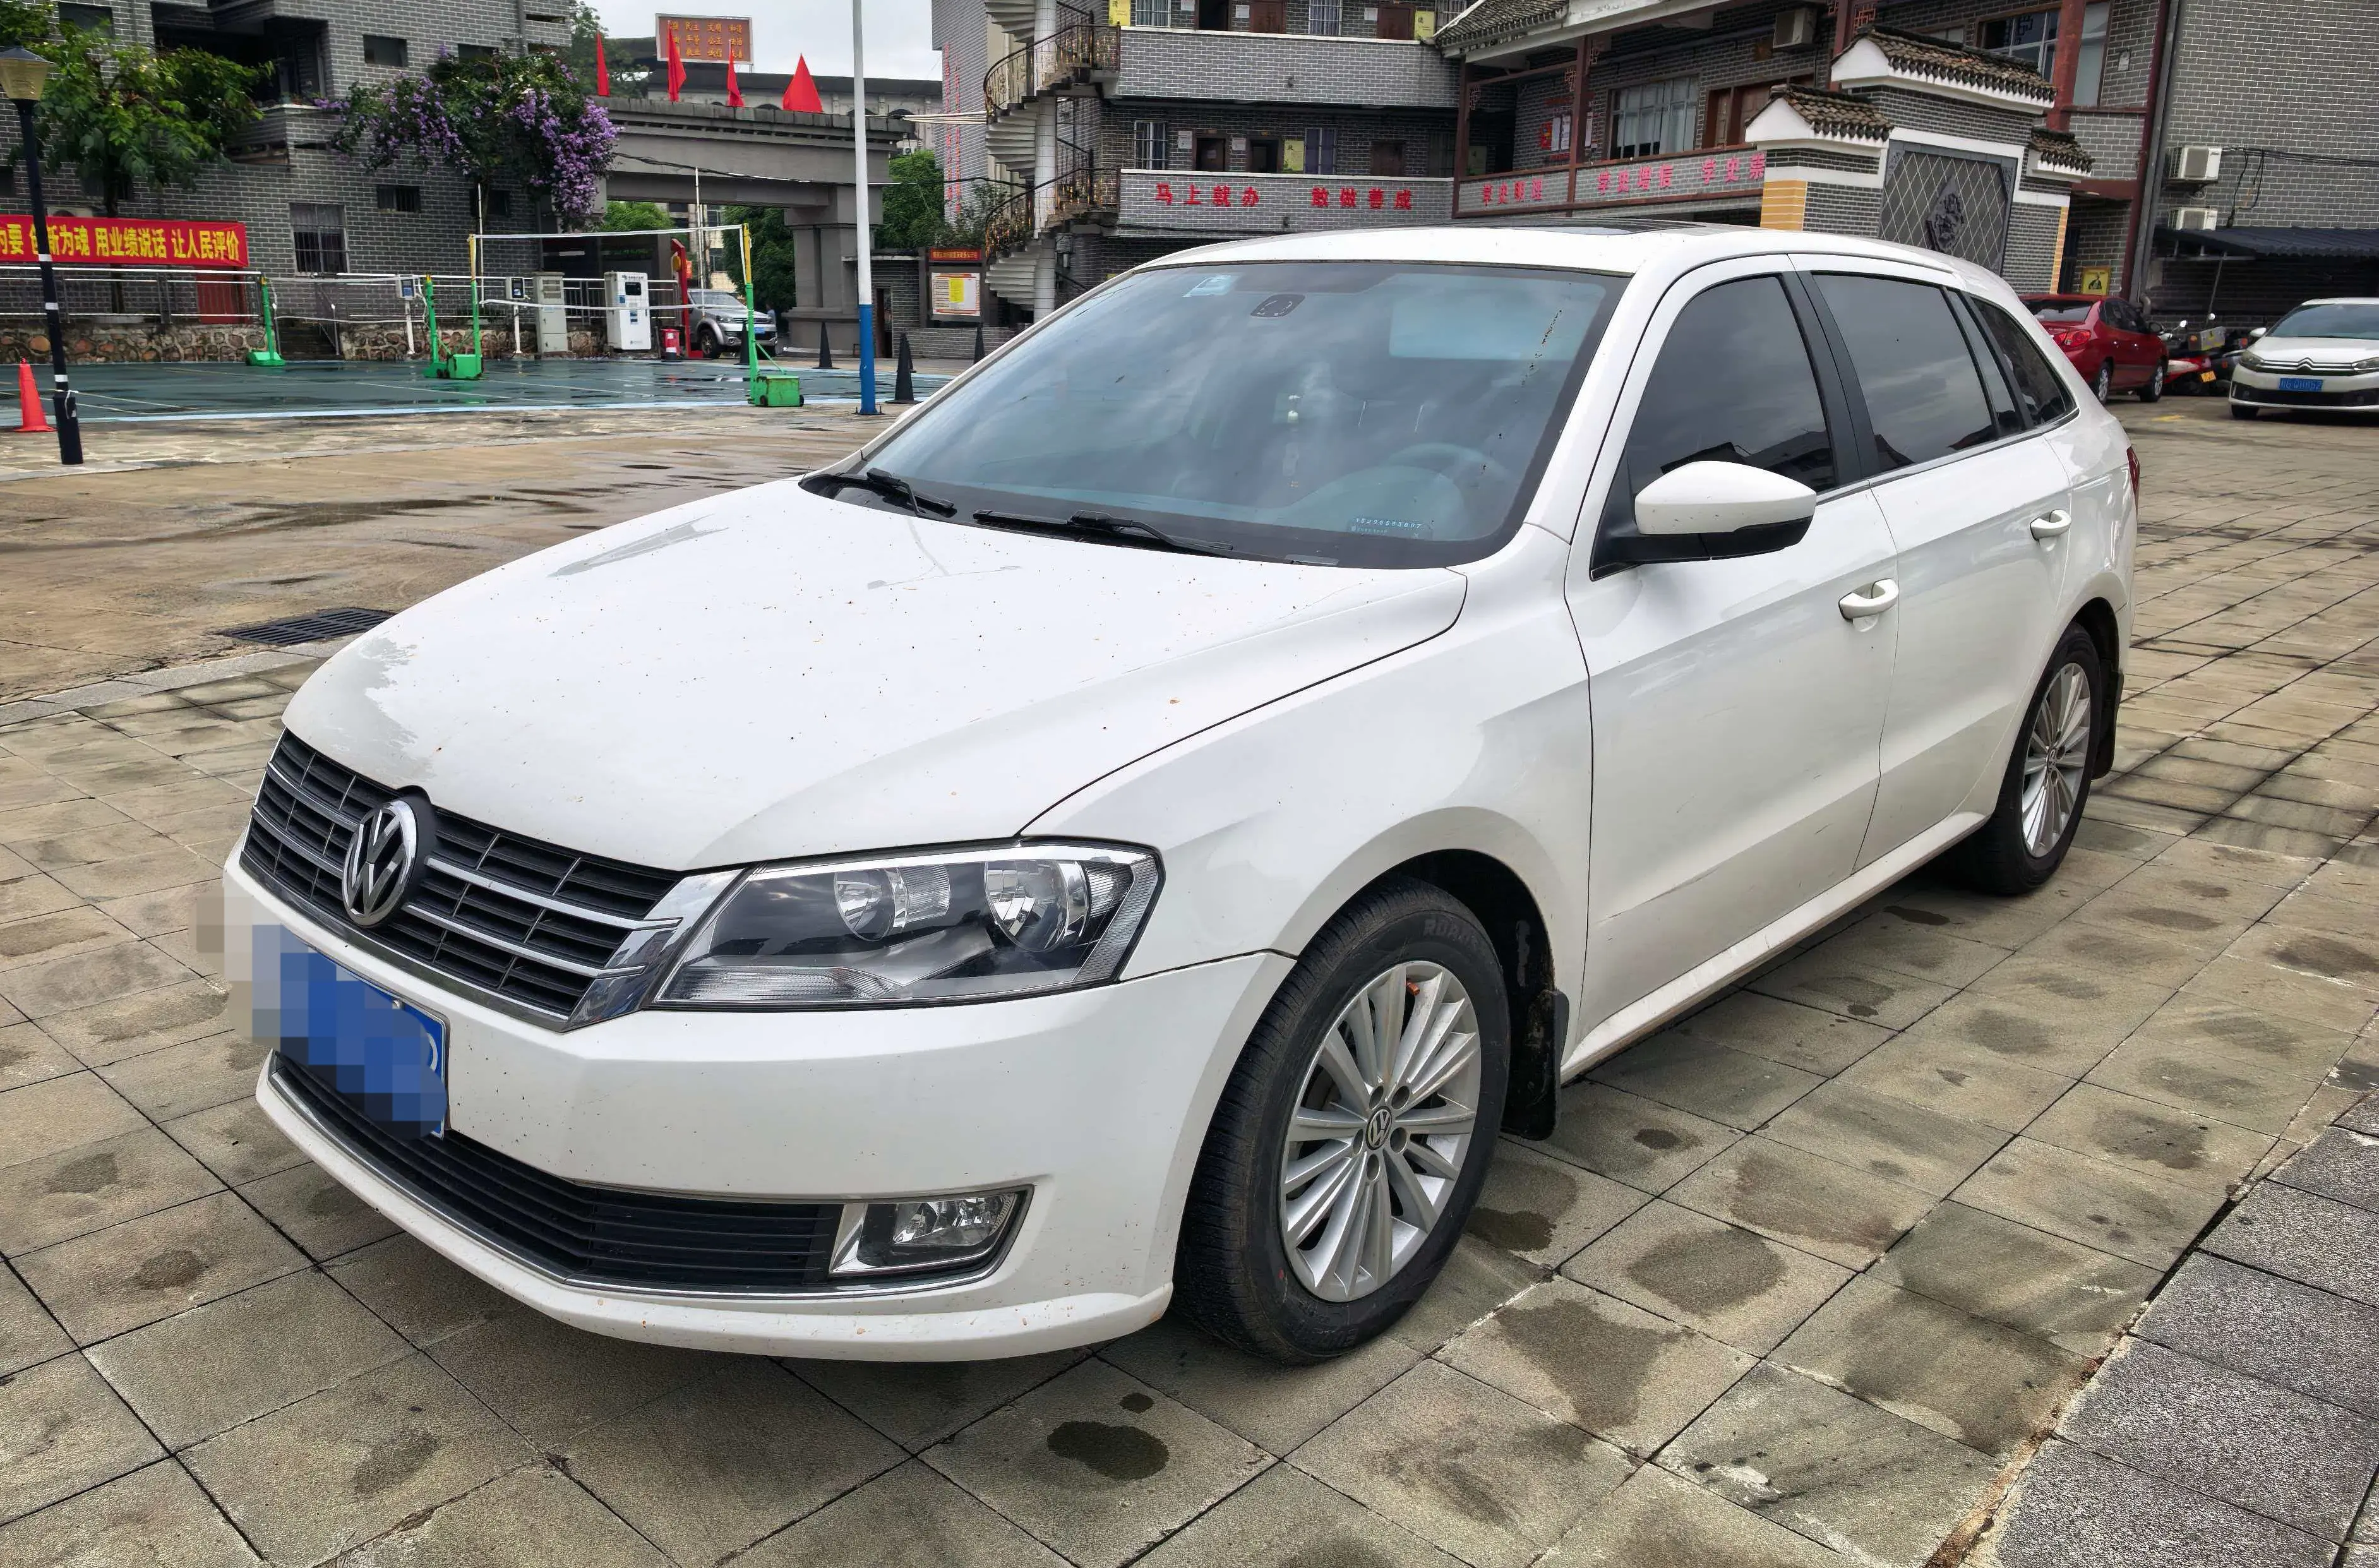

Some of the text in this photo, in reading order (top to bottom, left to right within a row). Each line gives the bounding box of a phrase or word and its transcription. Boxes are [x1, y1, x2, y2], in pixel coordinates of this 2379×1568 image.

[707, 23, 722, 32] 文明
[707, 37, 723, 45] 公正
[1155, 183, 1261, 208] 马上就办
[1482, 176, 1543, 205] 学史明理
[1597, 164, 1673, 195] 学史增信
[95, 225, 167, 259] 用业绩说话
[171, 227, 240, 261] 让人民评价
